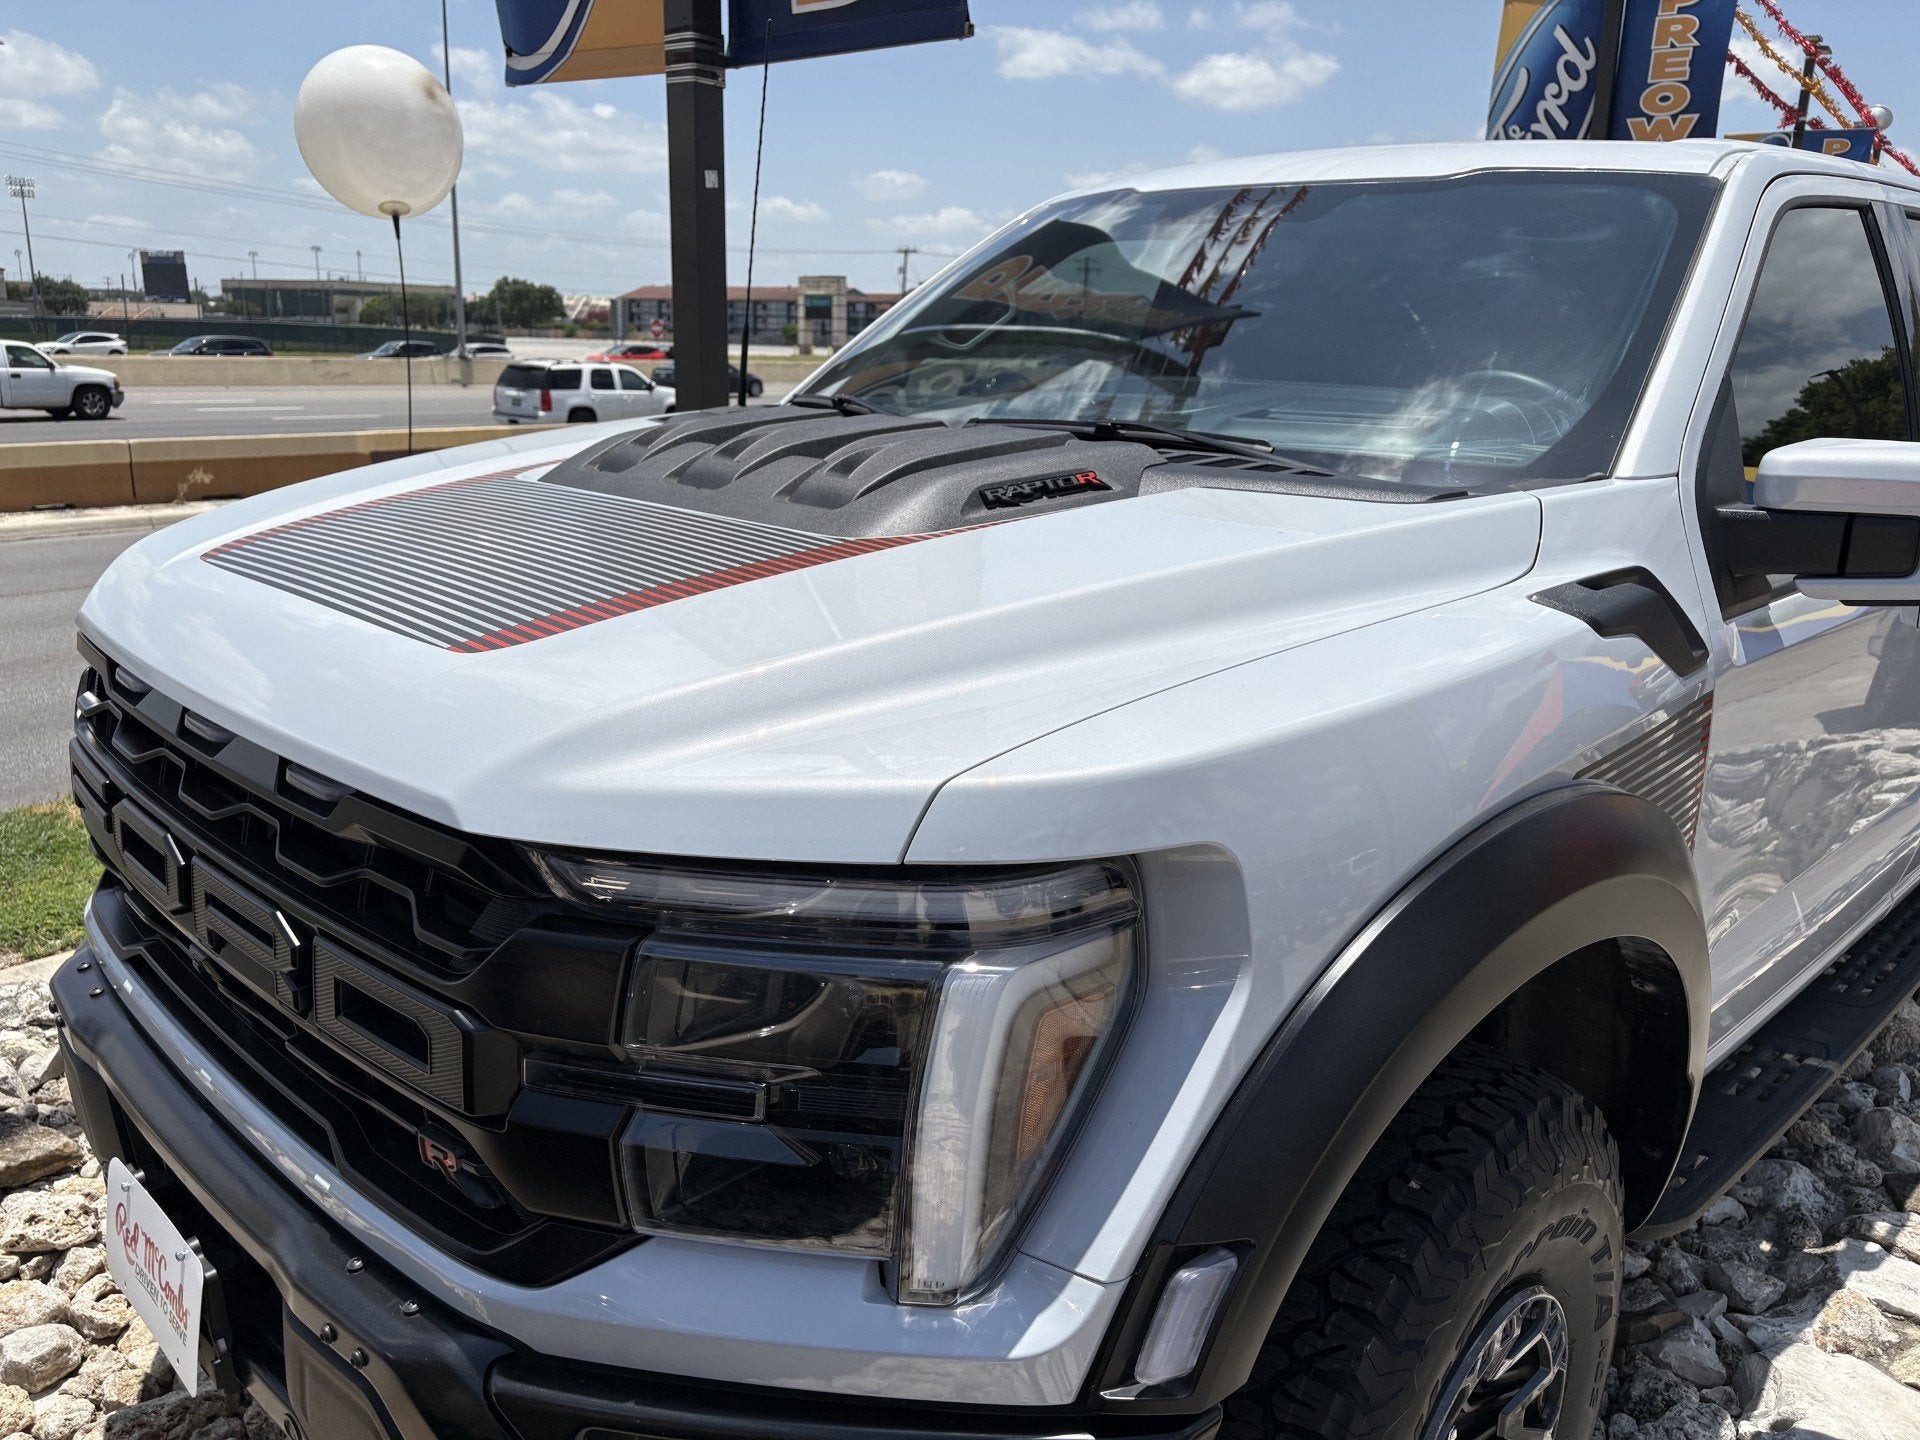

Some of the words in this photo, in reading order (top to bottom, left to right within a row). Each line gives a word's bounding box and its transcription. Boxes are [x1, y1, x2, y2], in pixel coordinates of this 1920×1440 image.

[983, 471, 1101, 501] RAPTOR
[69, 737, 470, 1112] FORD
[115, 1202, 139, 1266] Red
[141, 1227, 189, 1331] McCombs
[134, 1264, 159, 1300] DRIVEN
[160, 1294, 168, 1315] TO
[168, 1310, 188, 1347] SERVE
